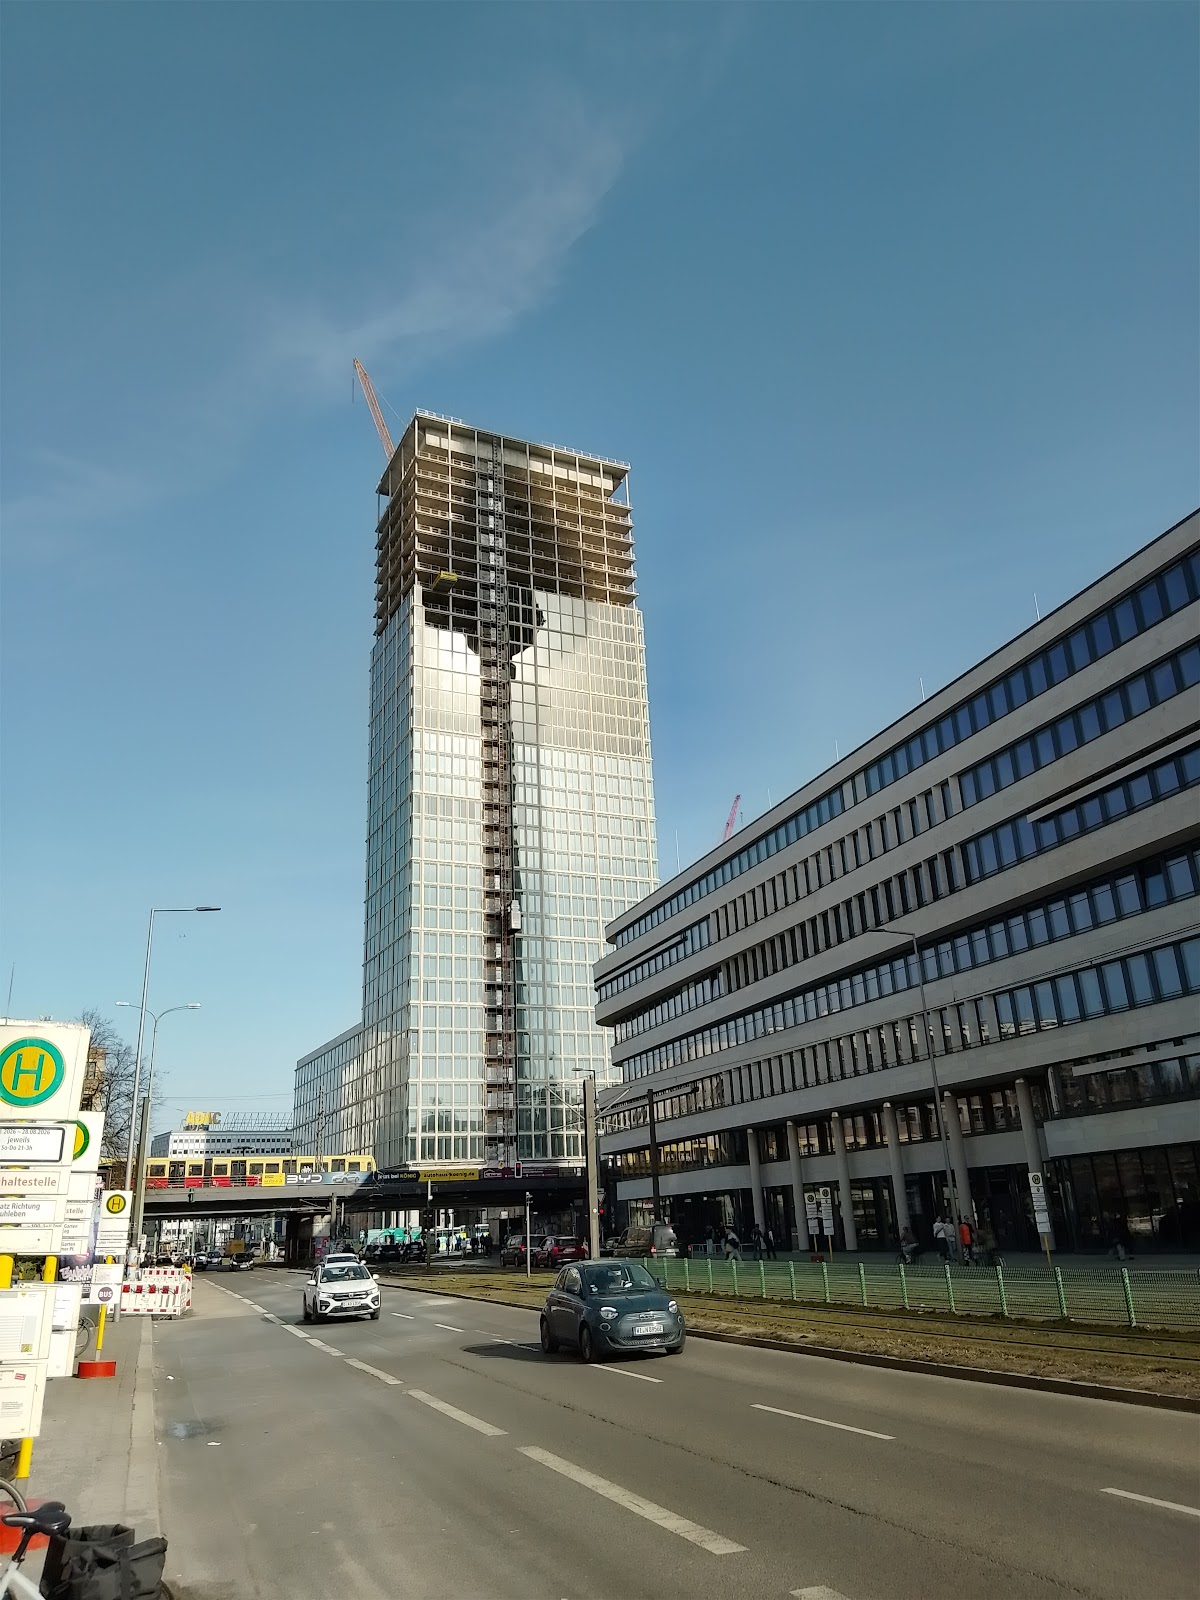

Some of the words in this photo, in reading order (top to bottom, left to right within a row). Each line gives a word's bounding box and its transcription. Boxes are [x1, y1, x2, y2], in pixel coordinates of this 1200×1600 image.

[12, 1053, 45, 1091] H
[185, 1111, 221, 1125] ADAC
[7, 1136, 30, 1145] jeweils
[286, 1174, 323, 1184] BYD
[11, 1202, 41, 1211] Richtung
[111, 1198, 121, 1210] H
